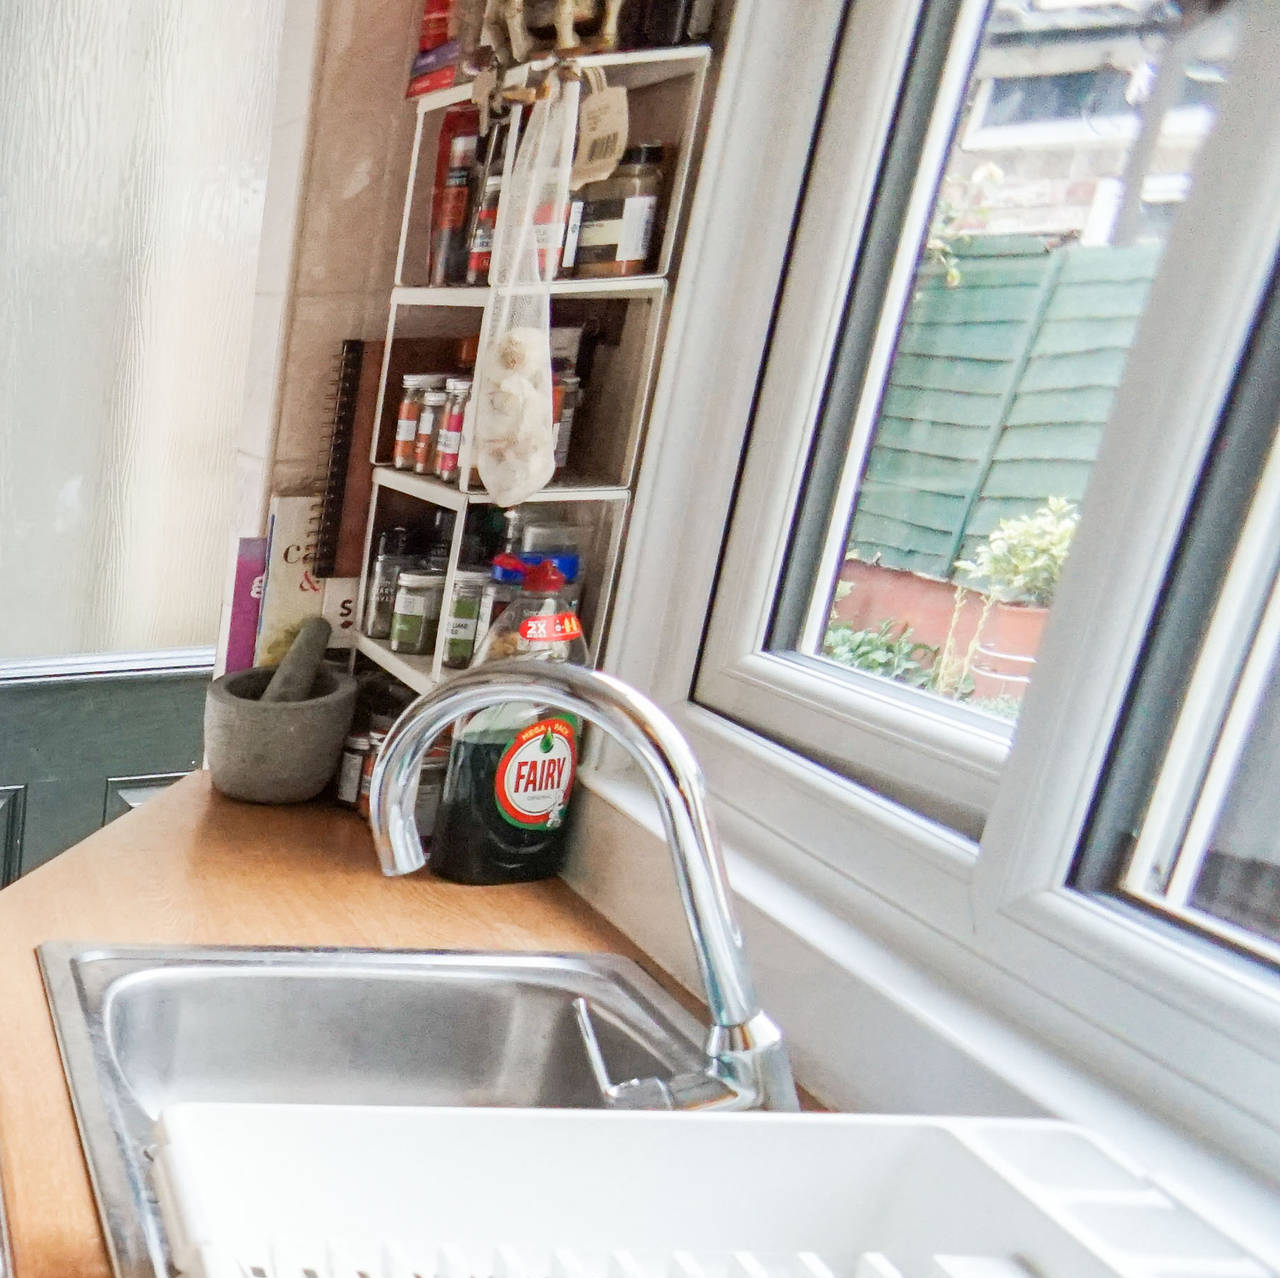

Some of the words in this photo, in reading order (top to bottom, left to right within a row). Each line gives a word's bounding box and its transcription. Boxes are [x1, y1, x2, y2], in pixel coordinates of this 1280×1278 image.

[527, 620, 547, 634] 2X
[521, 725, 547, 741] MEGA
[514, 757, 567, 793] FAIRY
